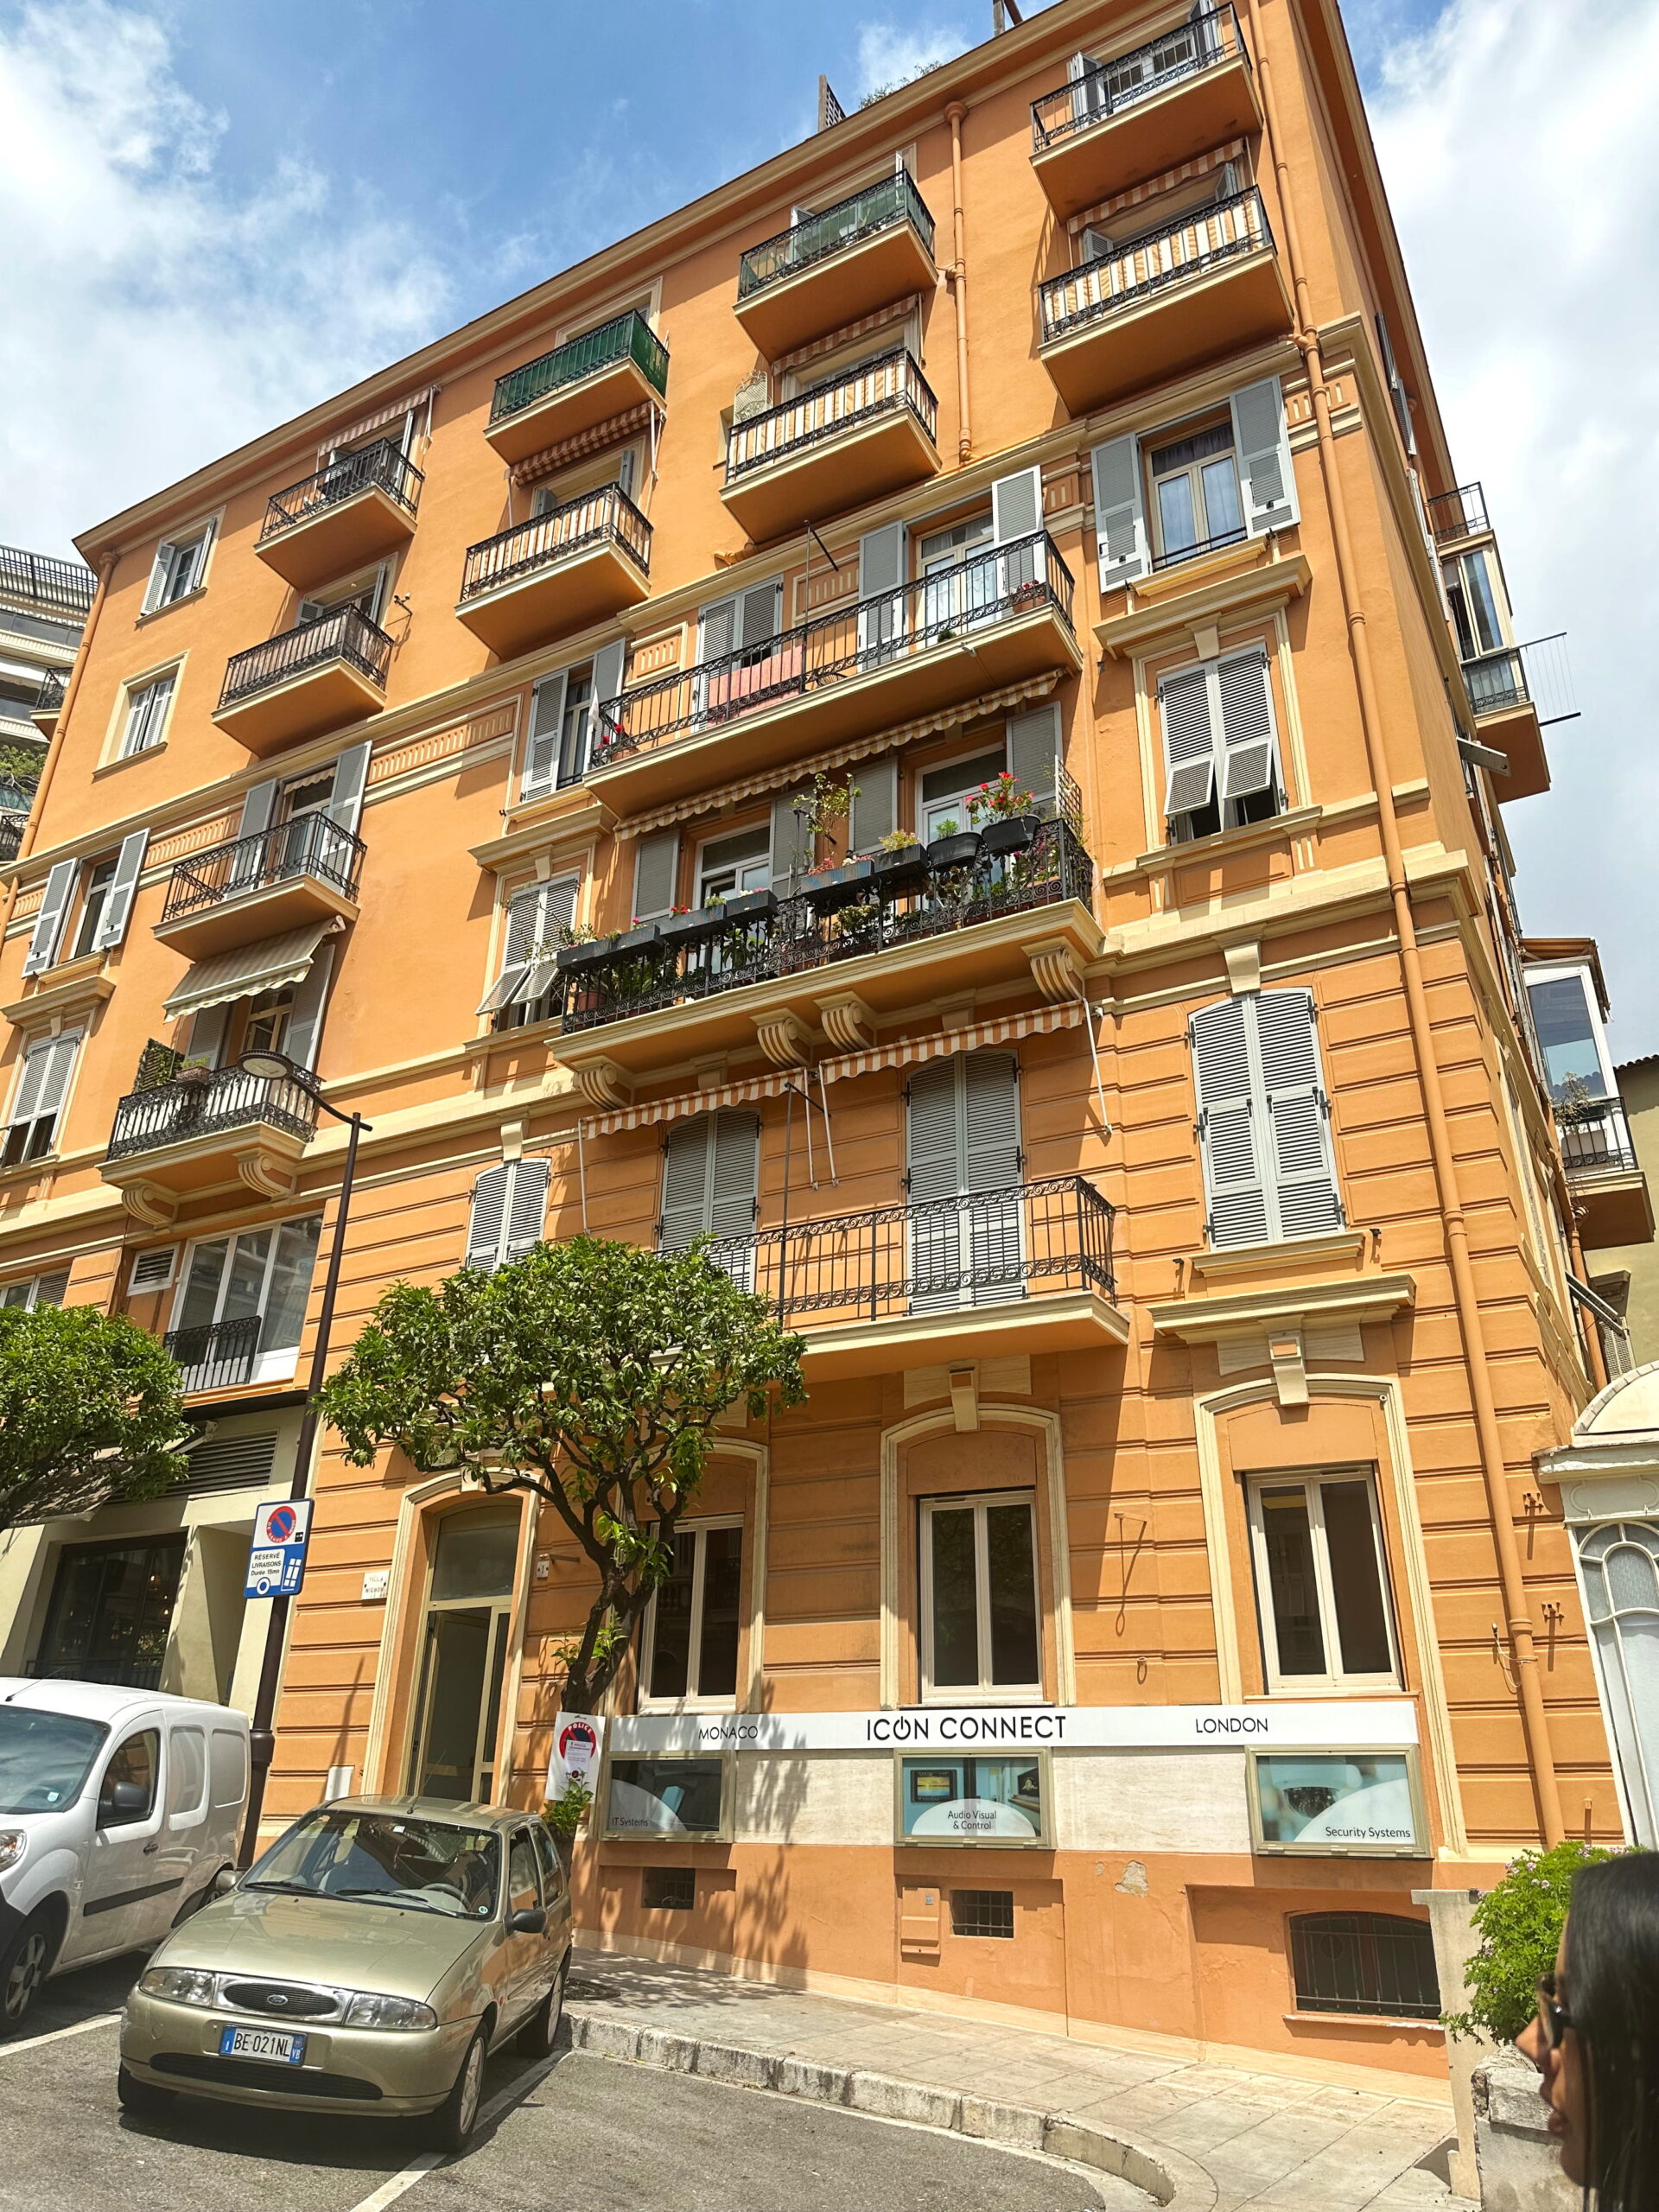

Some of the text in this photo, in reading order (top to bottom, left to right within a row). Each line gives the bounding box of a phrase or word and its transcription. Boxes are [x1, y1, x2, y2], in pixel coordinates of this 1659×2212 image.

[251, 1560, 282, 1569] LIVRAISONS
[568, 1723, 593, 1733] POLICE
[867, 1715, 1066, 1740] ICON CONNECT
[1196, 1717, 1268, 1733] LONDON
[698, 1726, 759, 1740] MONACO
[947, 1810, 997, 1820] Audio Visual
[612, 1816, 648, 1827] IT Systems
[953, 1821, 992, 1830] & Control
[1325, 1826, 1411, 1839] Security Systems
[234, 2033, 251, 2050] BE
[252, 2036, 289, 2056] 021NL
